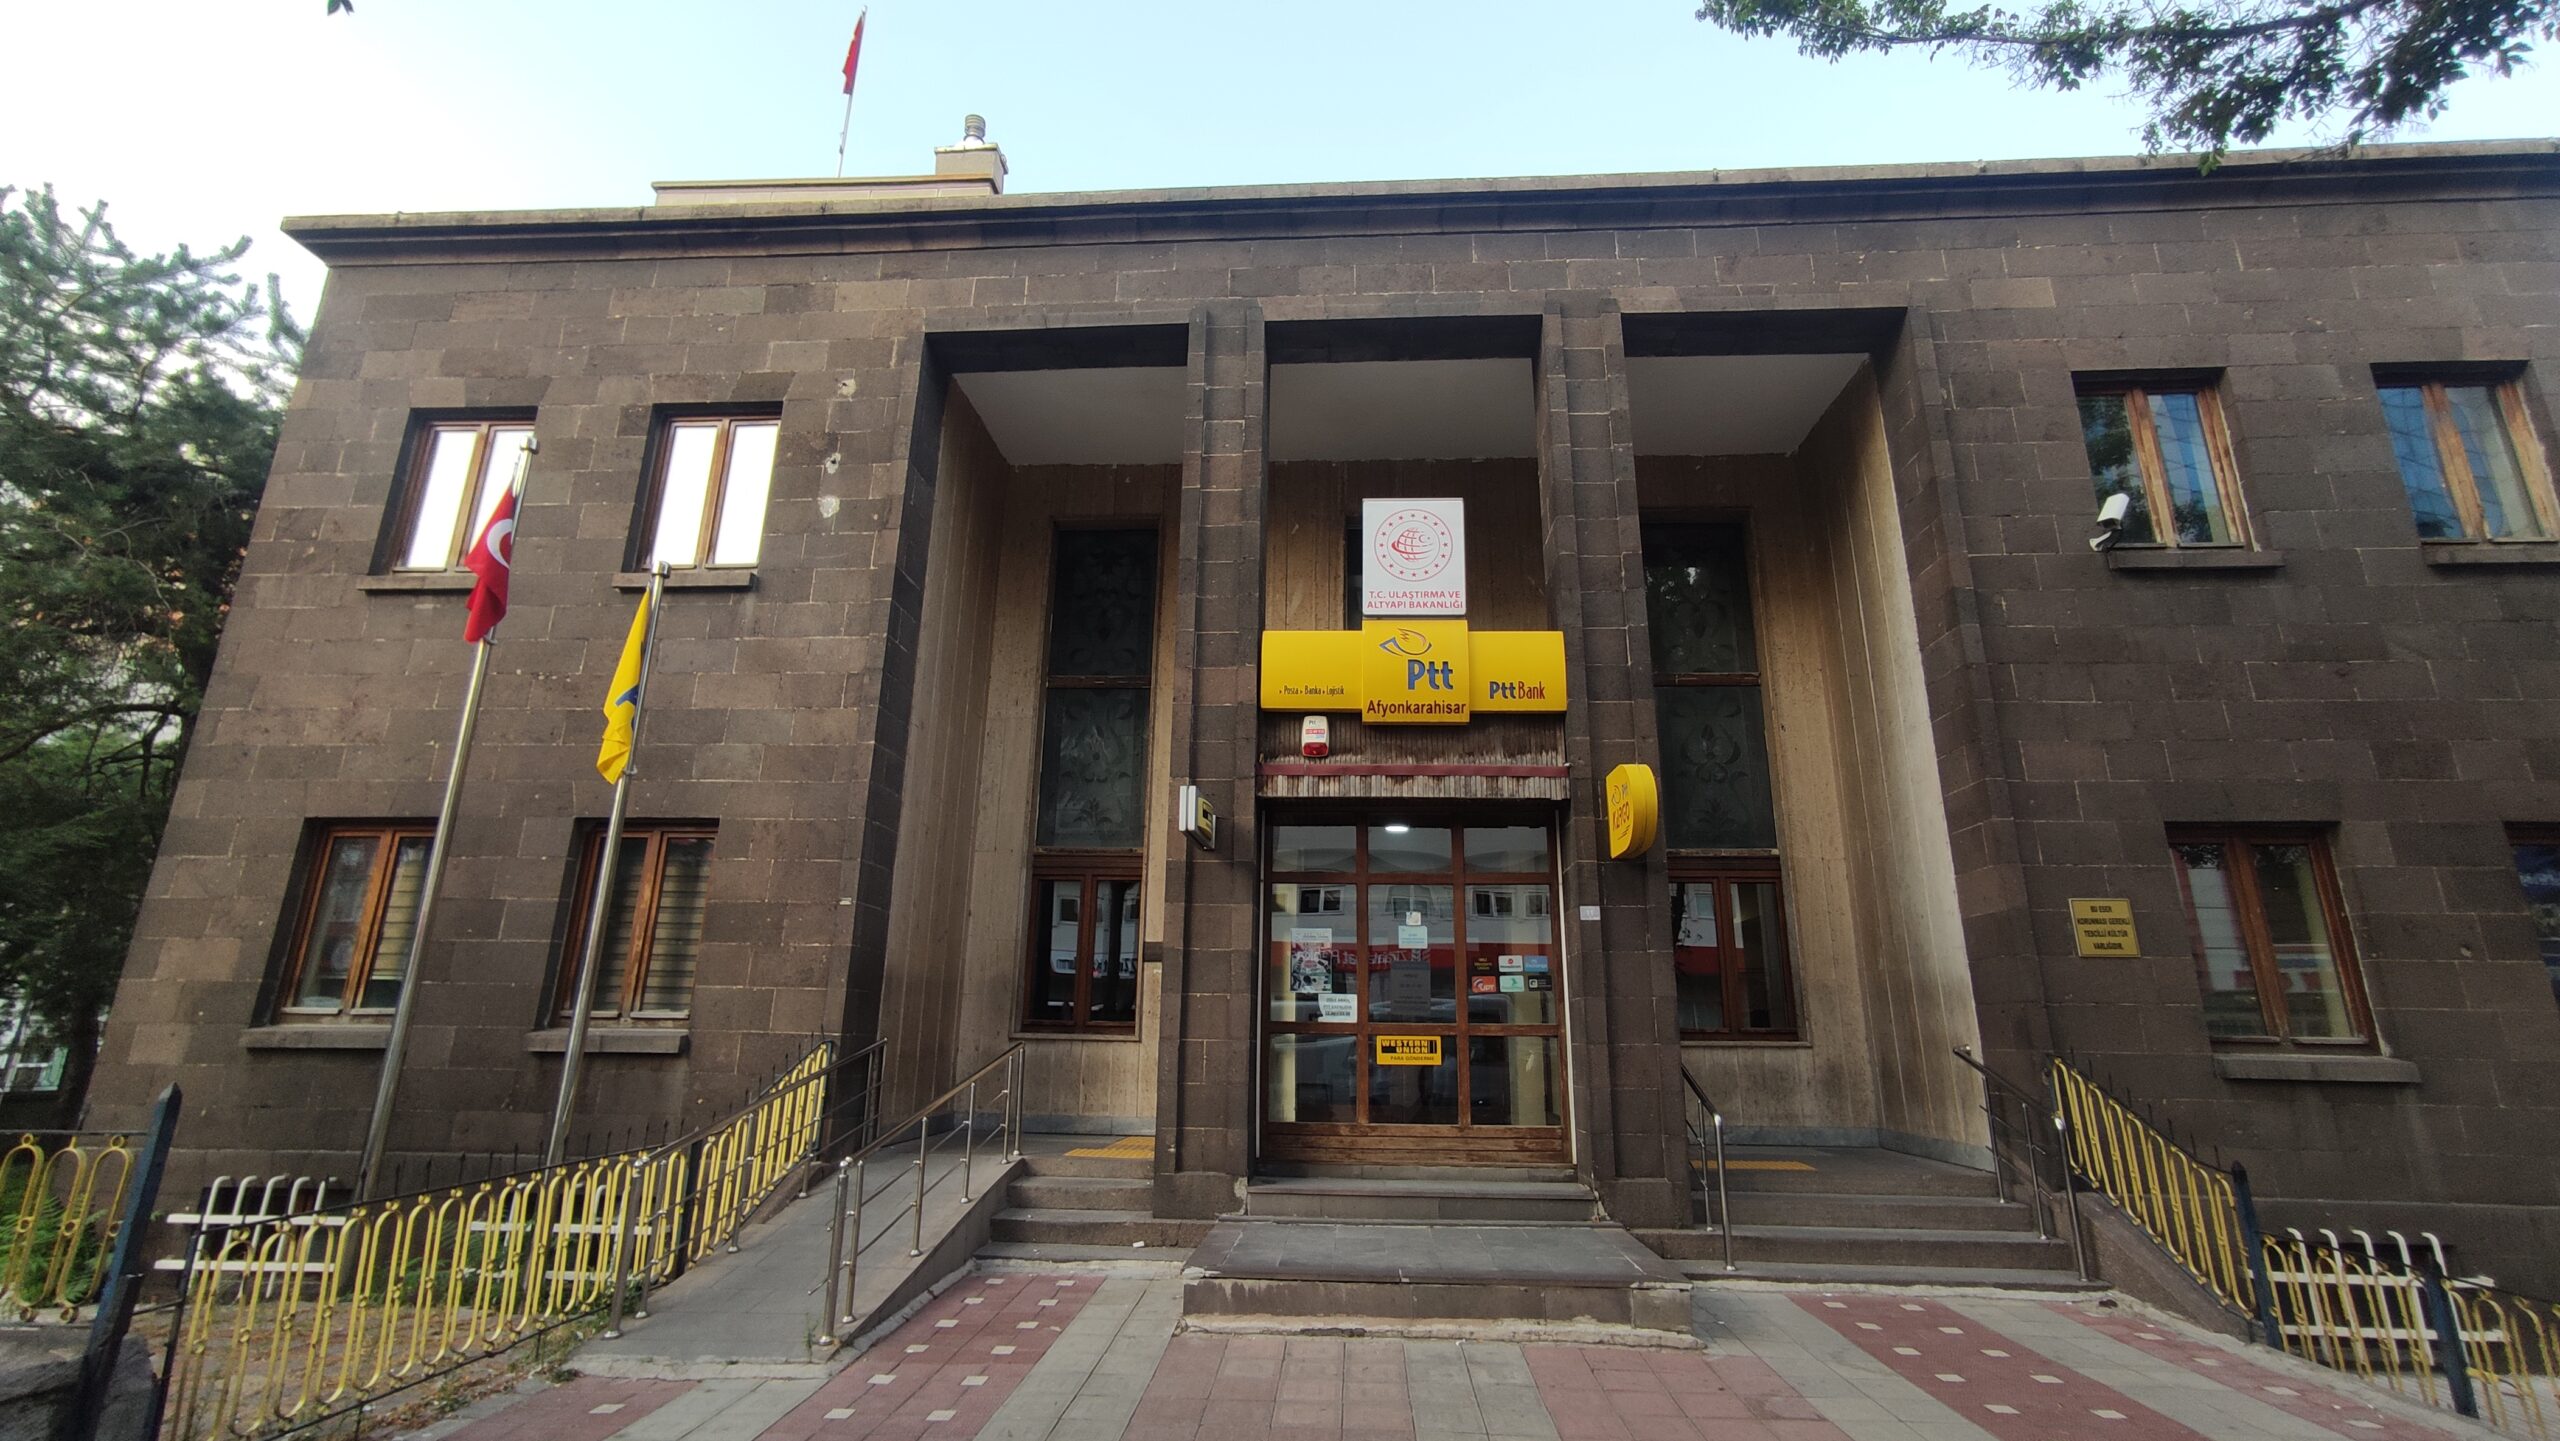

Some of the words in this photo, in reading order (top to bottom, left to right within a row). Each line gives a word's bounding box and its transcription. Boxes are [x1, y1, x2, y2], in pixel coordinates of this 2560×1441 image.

[1368, 590, 1386, 599] T.C.
[1388, 590, 1446, 600] ULAŞTIRMA
[1448, 590, 1461, 599] VE
[1367, 600, 1407, 609] ALTYAPI
[1409, 599, 1463, 609] BAKANLIĞI
[1407, 659, 1454, 690] Ptt
[1283, 685, 1299, 695] Posta
[1304, 685, 1321, 695] Banka
[1326, 685, 1344, 696] Lojistik
[1366, 699, 1467, 718] Afyonkarahisar
[1382, 1039, 1428, 1047] WESTERN
[1395, 1046, 1428, 1054] UNION
